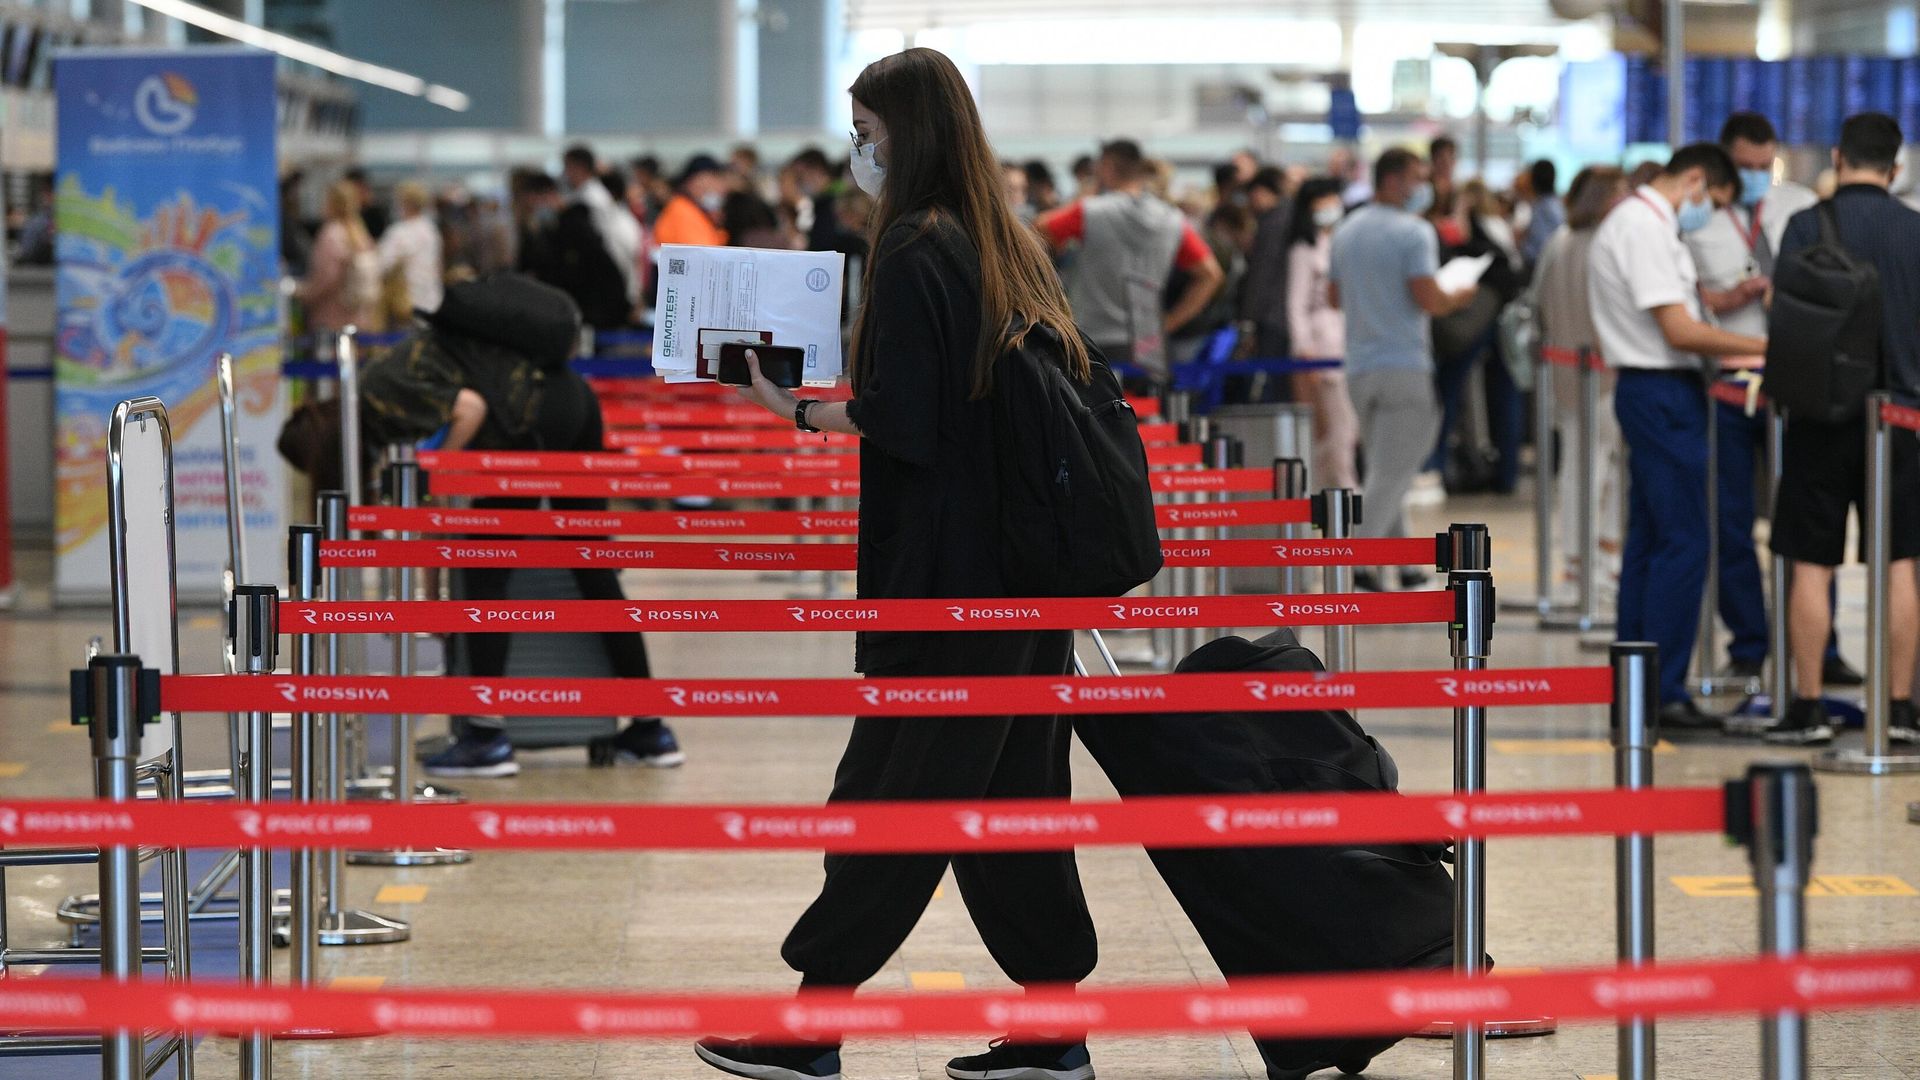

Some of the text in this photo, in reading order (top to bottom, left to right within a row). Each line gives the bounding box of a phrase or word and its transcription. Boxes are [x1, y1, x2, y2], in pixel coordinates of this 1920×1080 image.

[663, 287, 676, 358] GEMOTEST
[1182, 508, 1240, 518] ROSSIYA
[445, 515, 499, 526] ROSSIYA
[568, 517, 623, 527] РОССИЯ
[691, 518, 745, 528] ROSSIYA
[815, 518, 858, 527] РОССИ
[319, 548, 376, 558] РОССИЯ
[457, 548, 517, 558] ROSSIYA
[596, 549, 654, 559] РОССИЯ
[735, 551, 795, 561] ROSSIYA
[1160, 548, 1210, 558] ОССИЯ
[1293, 547, 1353, 557] ROSSIYA
[811, 609, 877, 620] РОССИЯ
[971, 608, 1040, 619] ROSSIYA
[1132, 606, 1198, 617] РОССИЯ
[1291, 603, 1359, 615] ROSSIYA
[323, 611, 394, 622] ROSSIYA
[488, 610, 554, 621] РОССИЯ
[649, 610, 719, 620] ROSSIYA
[1272, 684, 1356, 697] РОССИЯ
[1464, 679, 1550, 694] ROSSIYA
[303, 686, 389, 701] ROSSIYA
[499, 689, 582, 703] РОССИЯ
[693, 690, 778, 704] ROSSIYA
[886, 688, 968, 703] РОССИЯ
[1078, 687, 1166, 700] ROSSIYA
[1231, 808, 1340, 828] РОССИЯ
[1470, 804, 1582, 823] ROSSIYA
[23, 813, 135, 831] ROSSIYA
[265, 815, 373, 834] РОССИЯ
[504, 816, 616, 835] ROSSIYA
[749, 818, 857, 836] РОССИЯ
[987, 814, 1100, 834] ROSSIYA
